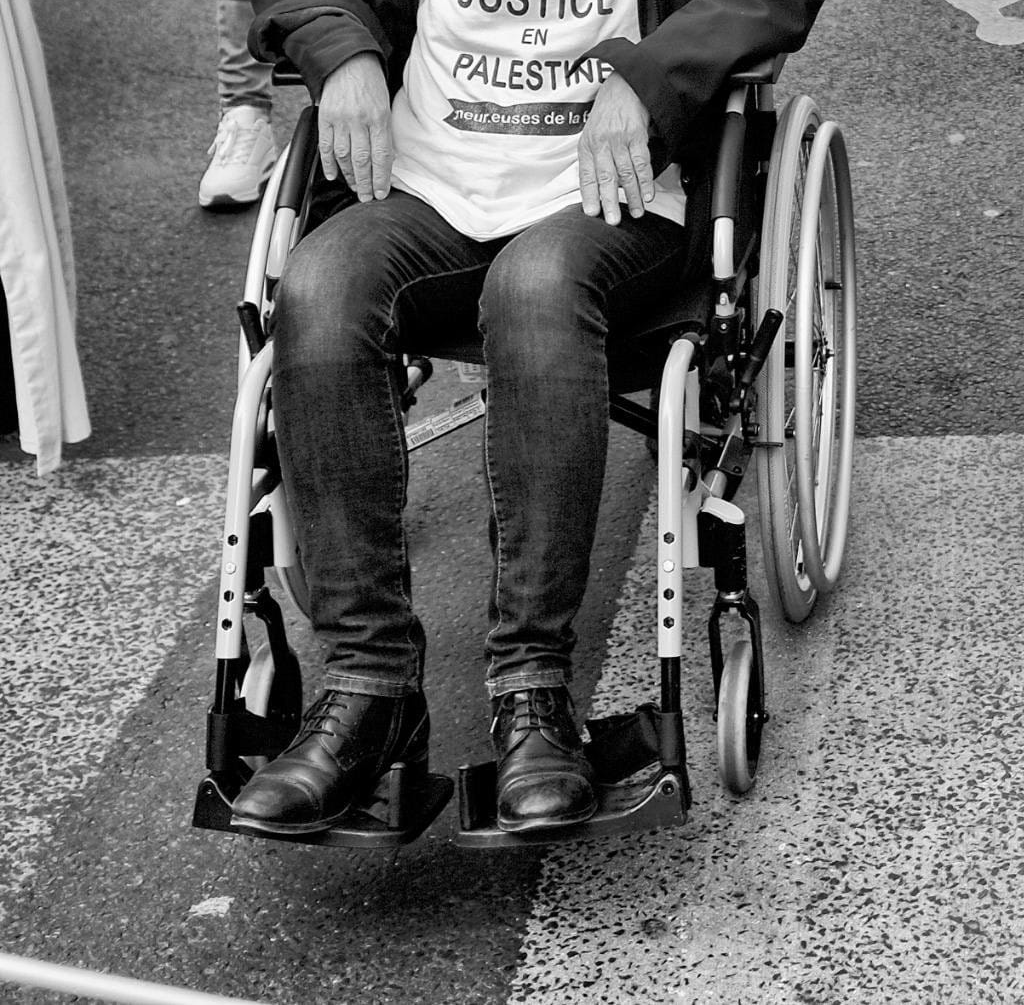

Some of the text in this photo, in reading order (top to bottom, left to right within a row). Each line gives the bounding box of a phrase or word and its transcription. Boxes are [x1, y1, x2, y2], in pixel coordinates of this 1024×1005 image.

[521, 28, 548, 45] EN
[452, 53, 614, 91] PALESTINE
[544, 111, 565, 125] de
[568, 111, 580, 125] la
